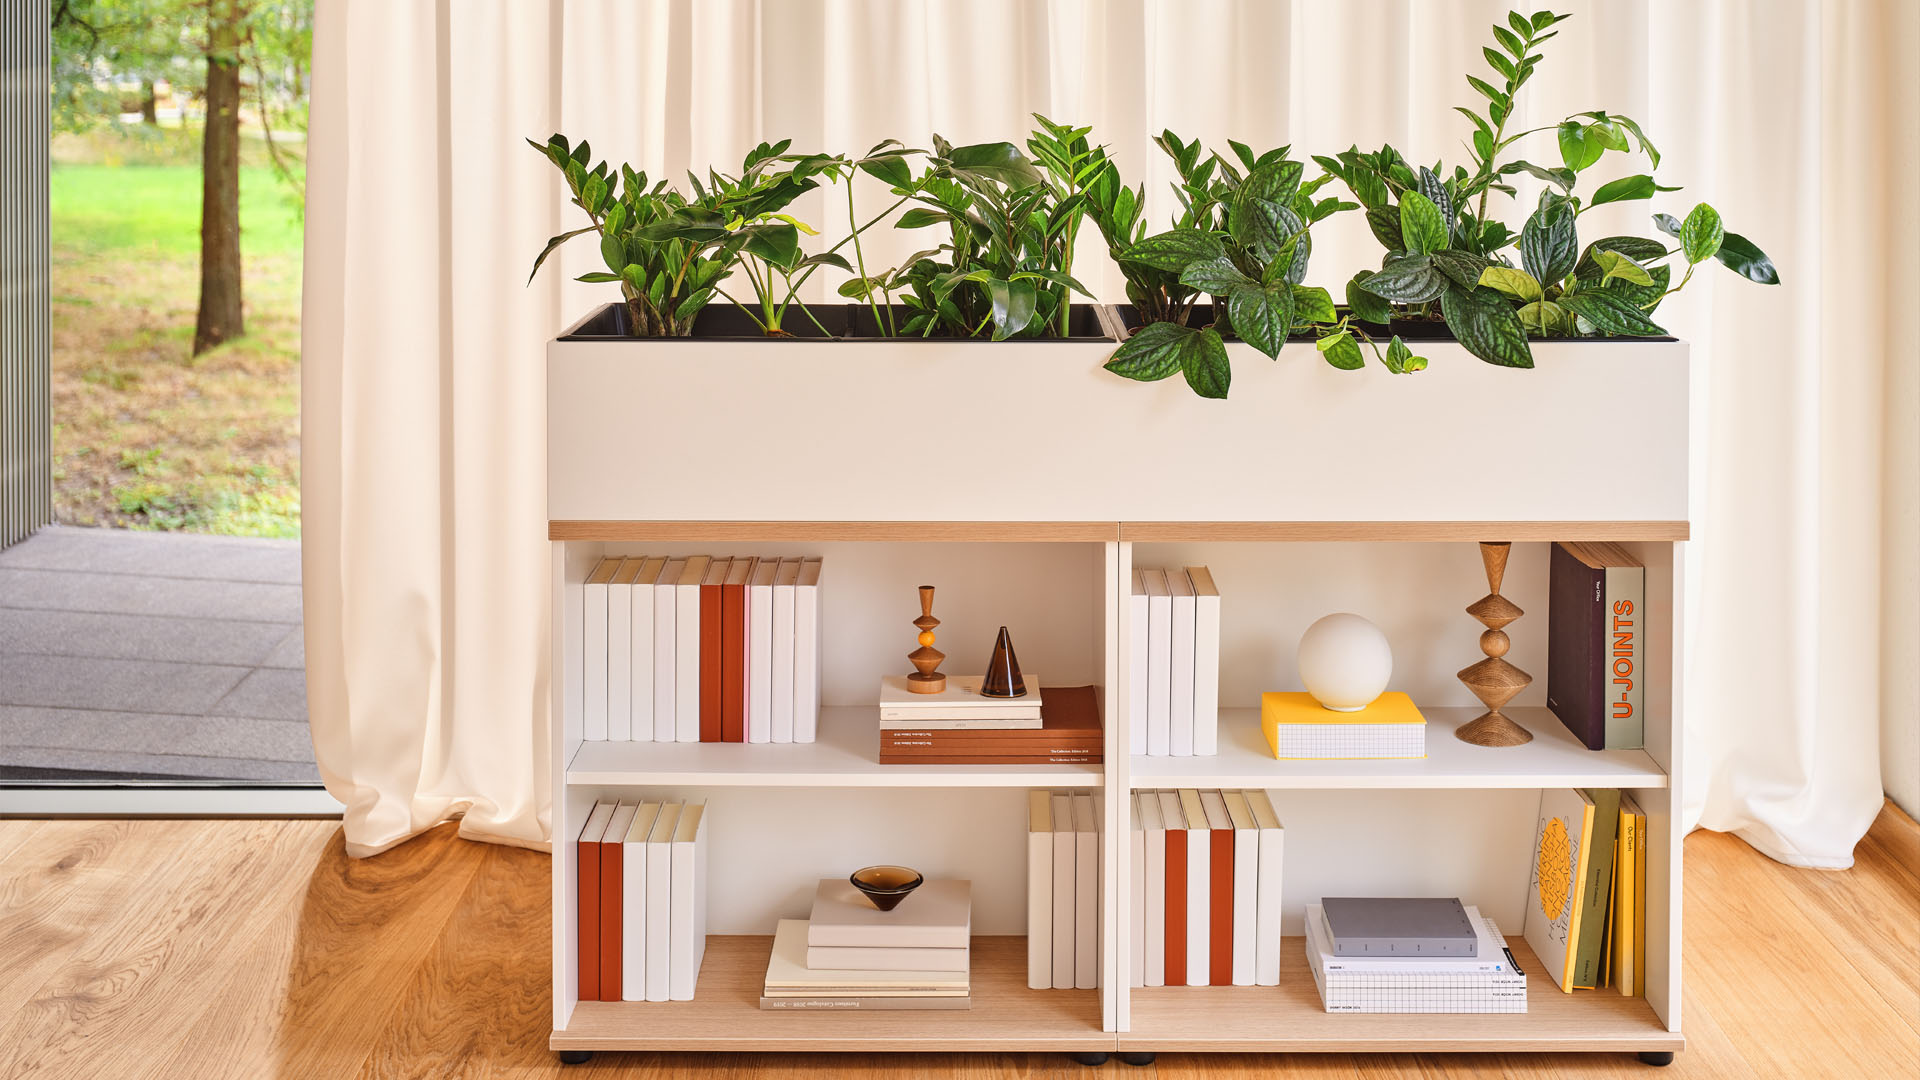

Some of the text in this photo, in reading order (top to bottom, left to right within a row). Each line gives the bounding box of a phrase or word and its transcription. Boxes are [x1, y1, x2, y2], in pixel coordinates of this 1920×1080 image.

[1613, 600, 1634, 718] U-JOINTS
[1532, 817, 1547, 889] MILANO
[1539, 832, 1551, 887] BERLIN
[1540, 817, 1558, 914] SHANGHAI
[1548, 839, 1561, 903] LISBON
[1556, 838, 1573, 928] CHICAGO
[1559, 834, 1579, 945] MELBOURNE
